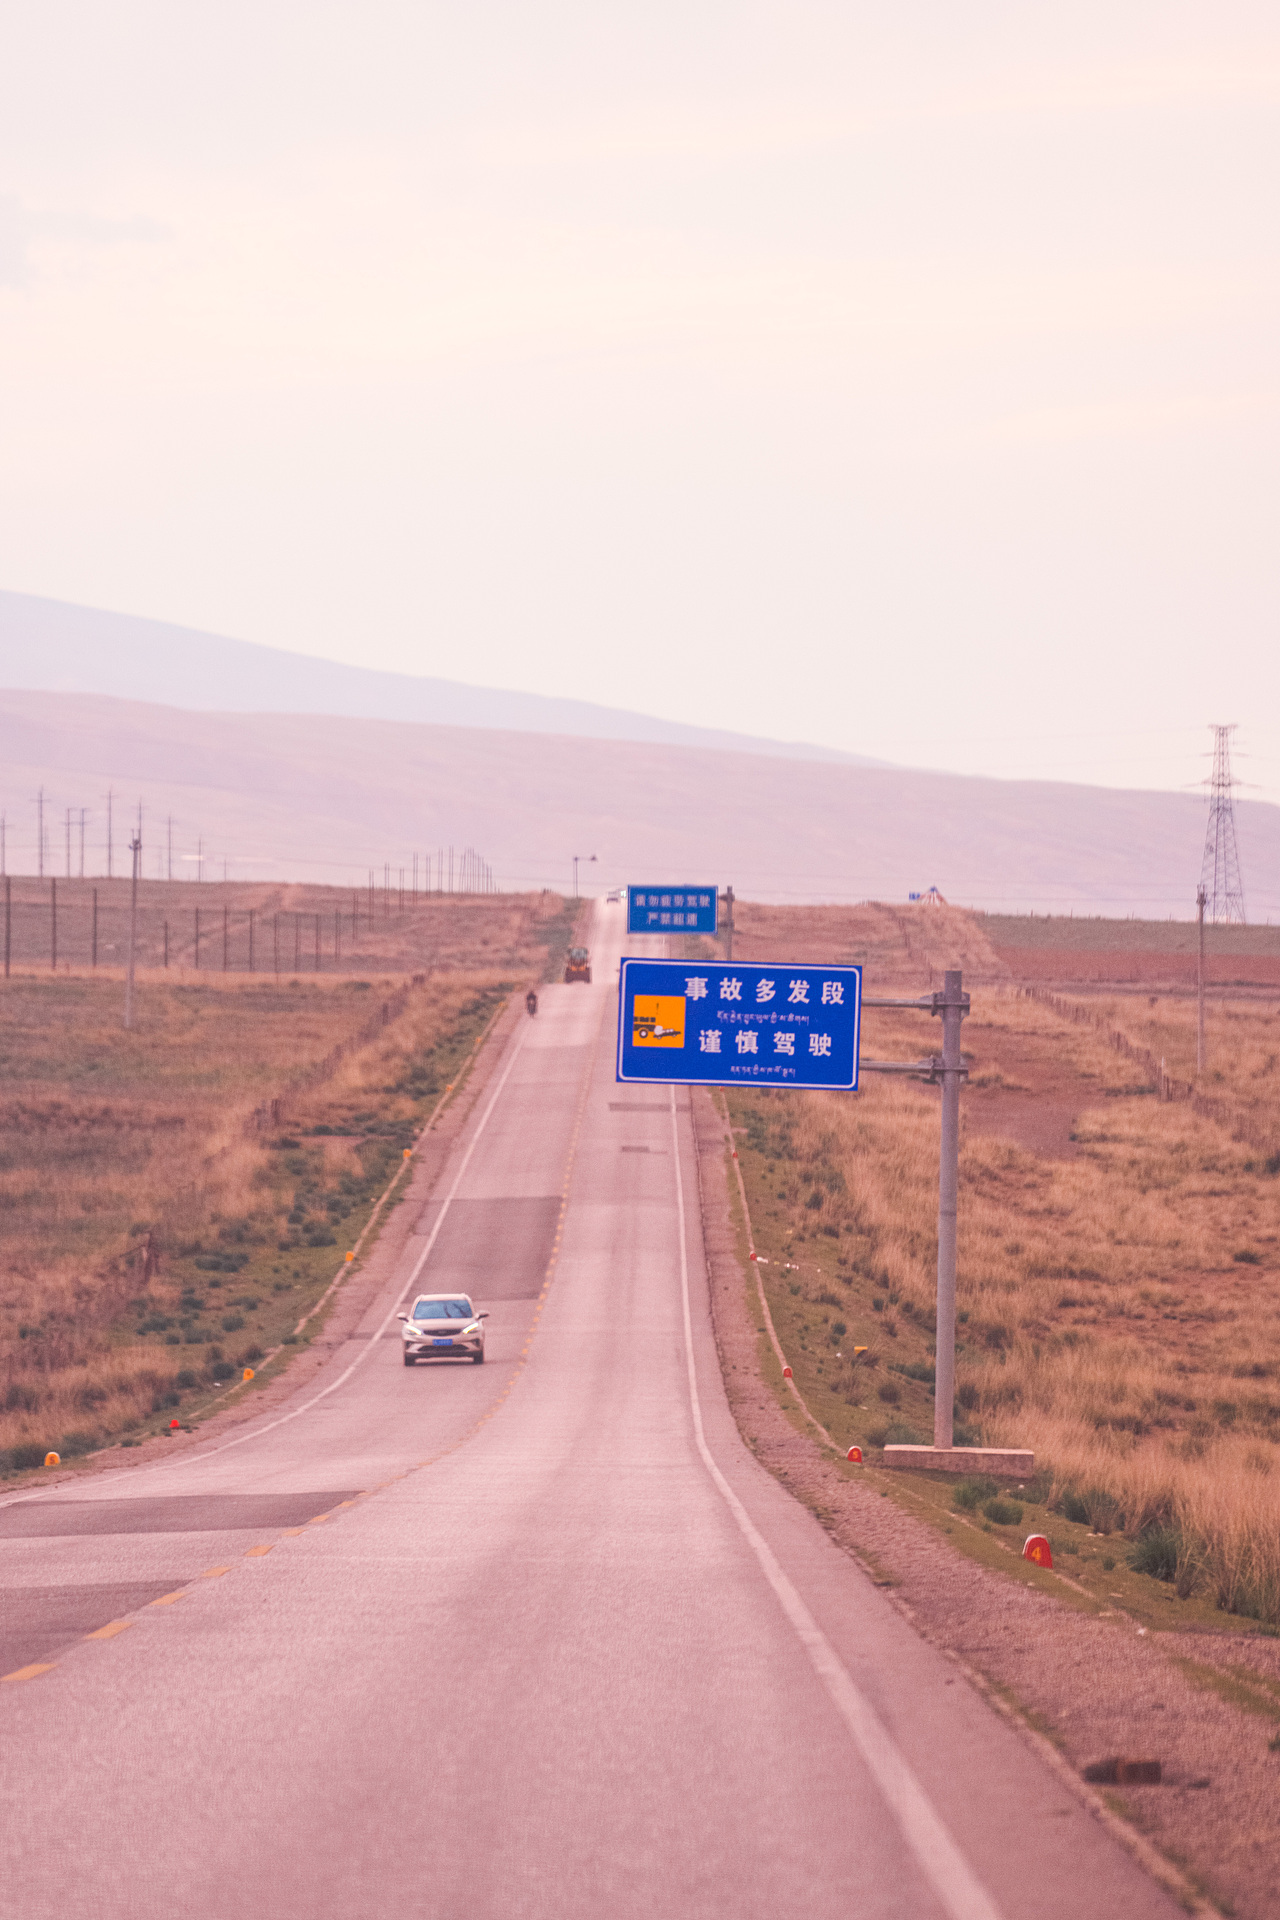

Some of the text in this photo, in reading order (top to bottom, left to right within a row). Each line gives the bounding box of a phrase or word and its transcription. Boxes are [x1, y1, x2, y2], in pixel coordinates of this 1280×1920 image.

[684, 976, 845, 1005] 事故多发段
[698, 1029, 832, 1057] 谨慎驾驶
[1031, 1546, 1041, 1561] 4
